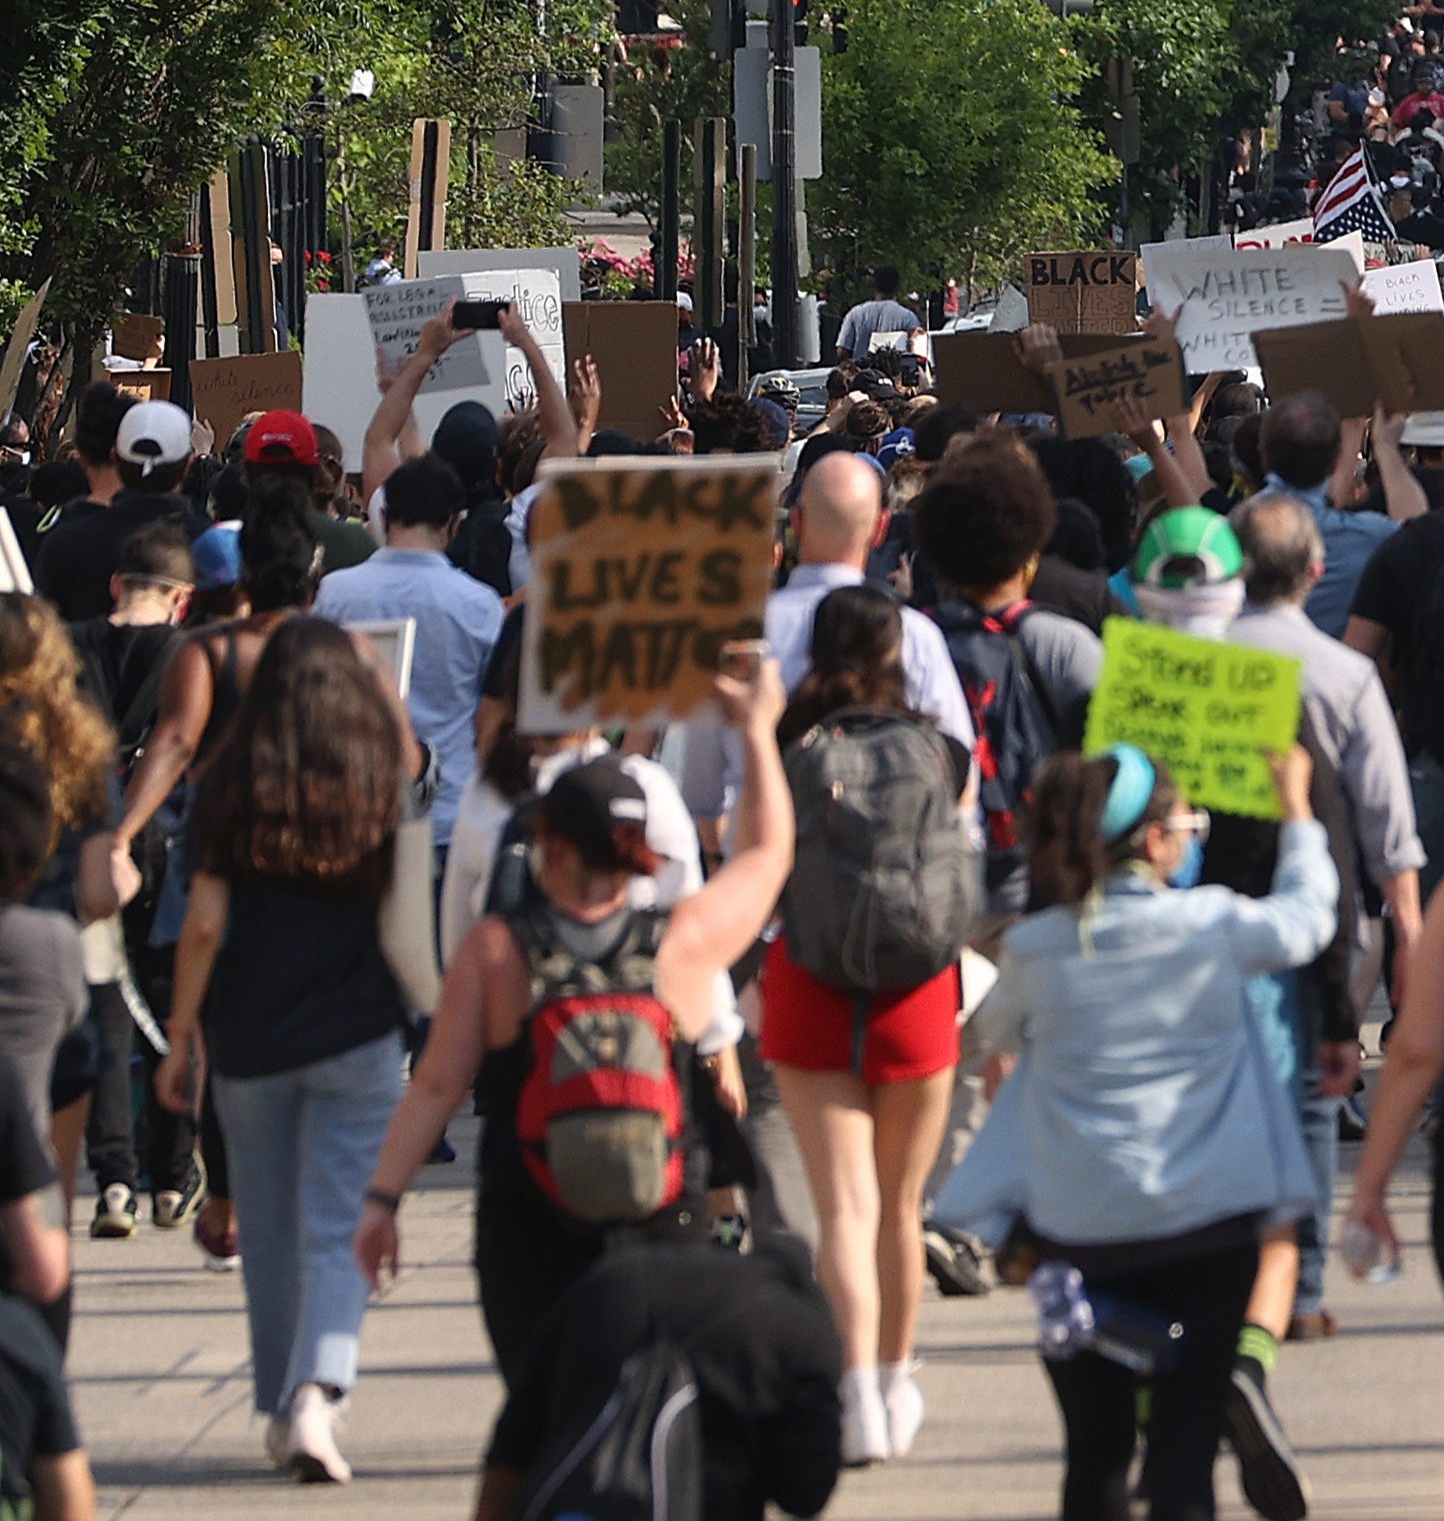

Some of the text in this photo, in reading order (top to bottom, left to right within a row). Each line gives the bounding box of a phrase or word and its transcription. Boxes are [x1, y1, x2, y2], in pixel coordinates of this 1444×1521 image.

[1031, 256, 1132, 286] BLACK
[1172, 267, 1296, 302] WHITE
[1033, 287, 1130, 317] LIVES
[1208, 297, 1305, 321] SILENCE
[552, 469, 770, 531] BLACK
[550, 547, 744, 612] LIVES
